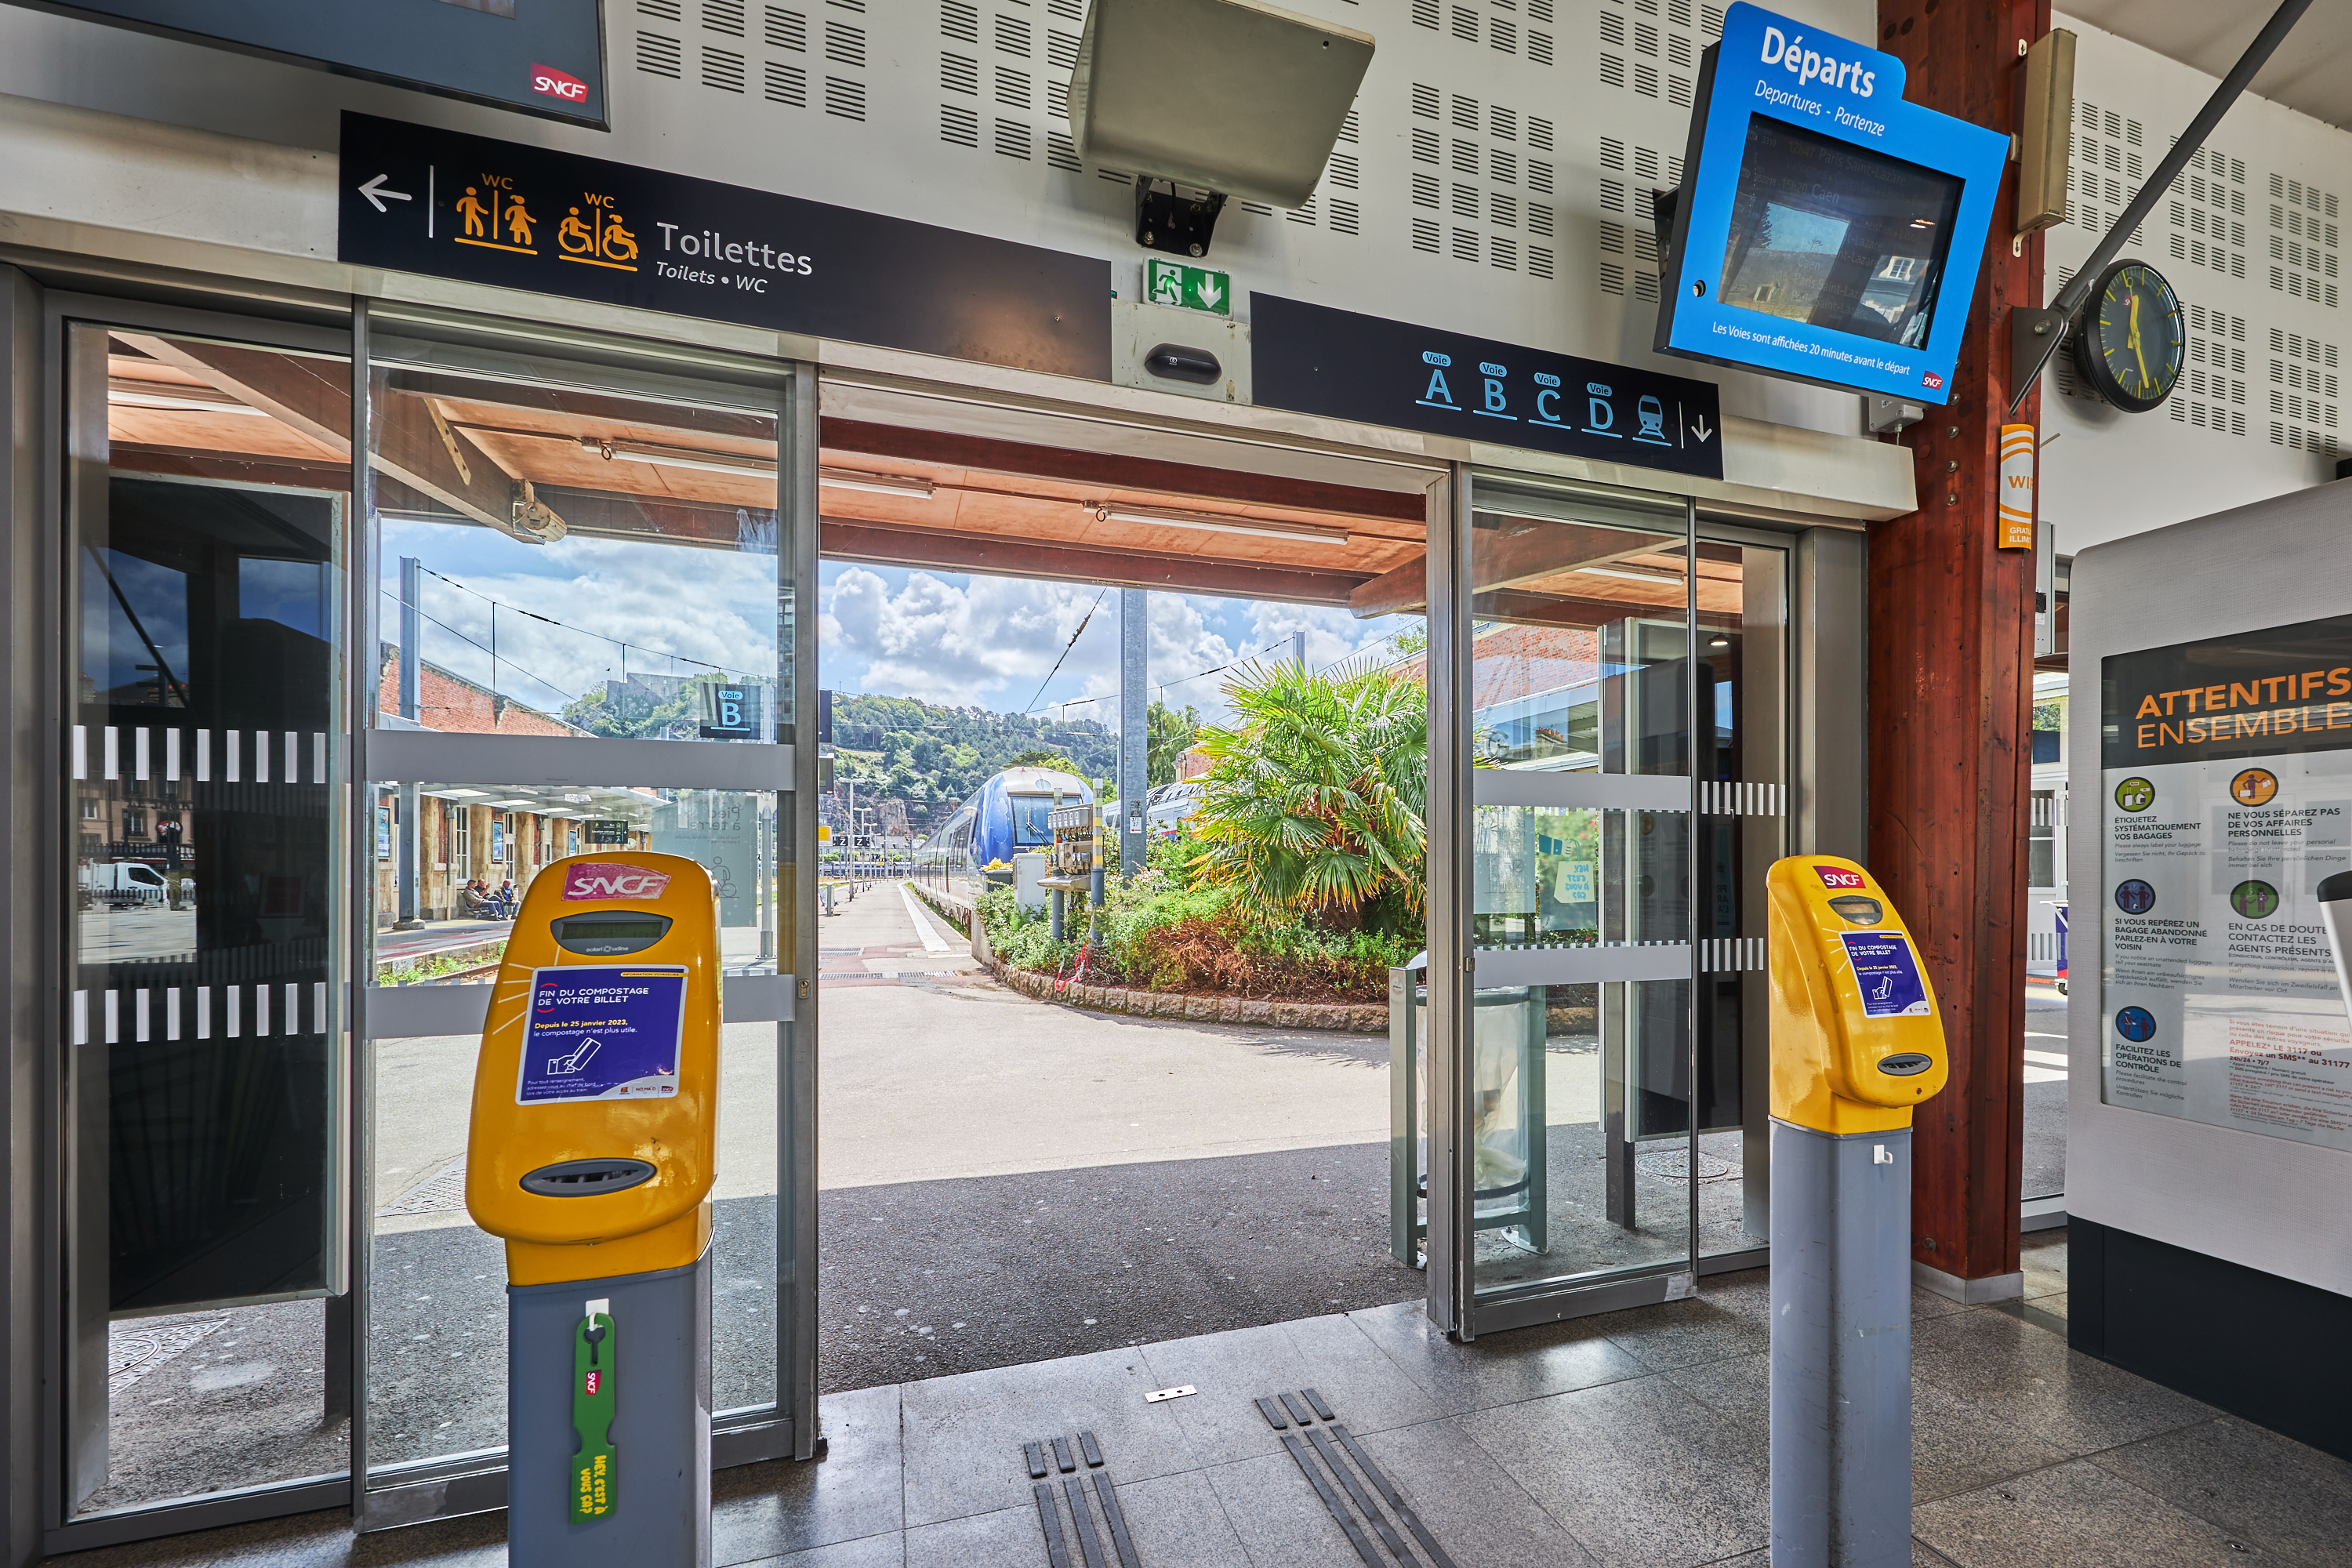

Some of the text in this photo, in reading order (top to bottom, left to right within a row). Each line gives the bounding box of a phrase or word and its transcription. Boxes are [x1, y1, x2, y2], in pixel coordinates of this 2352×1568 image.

[1761, 27, 1875, 97] Départs
[534, 77, 586, 98] SNCF
[1755, 80, 1885, 136] Departures Partenze
[482, 173, 514, 190] WC
[585, 192, 614, 209] WC
[1812, 183, 1839, 204] Caen
[656, 222, 812, 275] Toilettes
[657, 261, 768, 293] Toilets WC
[1713, 321, 1910, 376] Les Voies sont affichées 20 minutes avant le départ
[1427, 353, 1447, 365] Voie
[1483, 364, 1503, 376] Voie
[1426, 369, 1453, 403] A
[1537, 375, 1557, 386] Voie
[1590, 384, 1609, 395] Voie
[1923, 377, 1942, 387] SNCF
[1484, 379, 1506, 412] B
[1537, 390, 1560, 421] C
[1590, 397, 1613, 430] D
[2135, 667, 2351, 719] ATTENTIFS
[722, 702, 741, 725] B
[2137, 702, 2351, 748] ENSEMBLE
[2274, 809, 2318, 818] SÉPAREZ
[2115, 823, 2201, 832] SYSTÉMATIQUEMENT
[568, 876, 664, 895] SNCF
[1824, 874, 1859, 886] SNCF
[2151, 928, 2207, 937] ABANDONNÉ
[2229, 933, 2293, 943] CONTACTEZ
[2229, 944, 2331, 956] AGENTS PRÉSENTS
[2116, 1044, 2154, 1055] FACILITEZ
[2116, 1052, 2167, 1065] OPÉRATIONS
[2230, 1047, 2263, 1057] Envoyez
[2322, 1059, 2350, 1068] 31177
[2116, 1061, 2159, 1073] CONTRÔLE
[580, 1468, 592, 1492] VOUS
